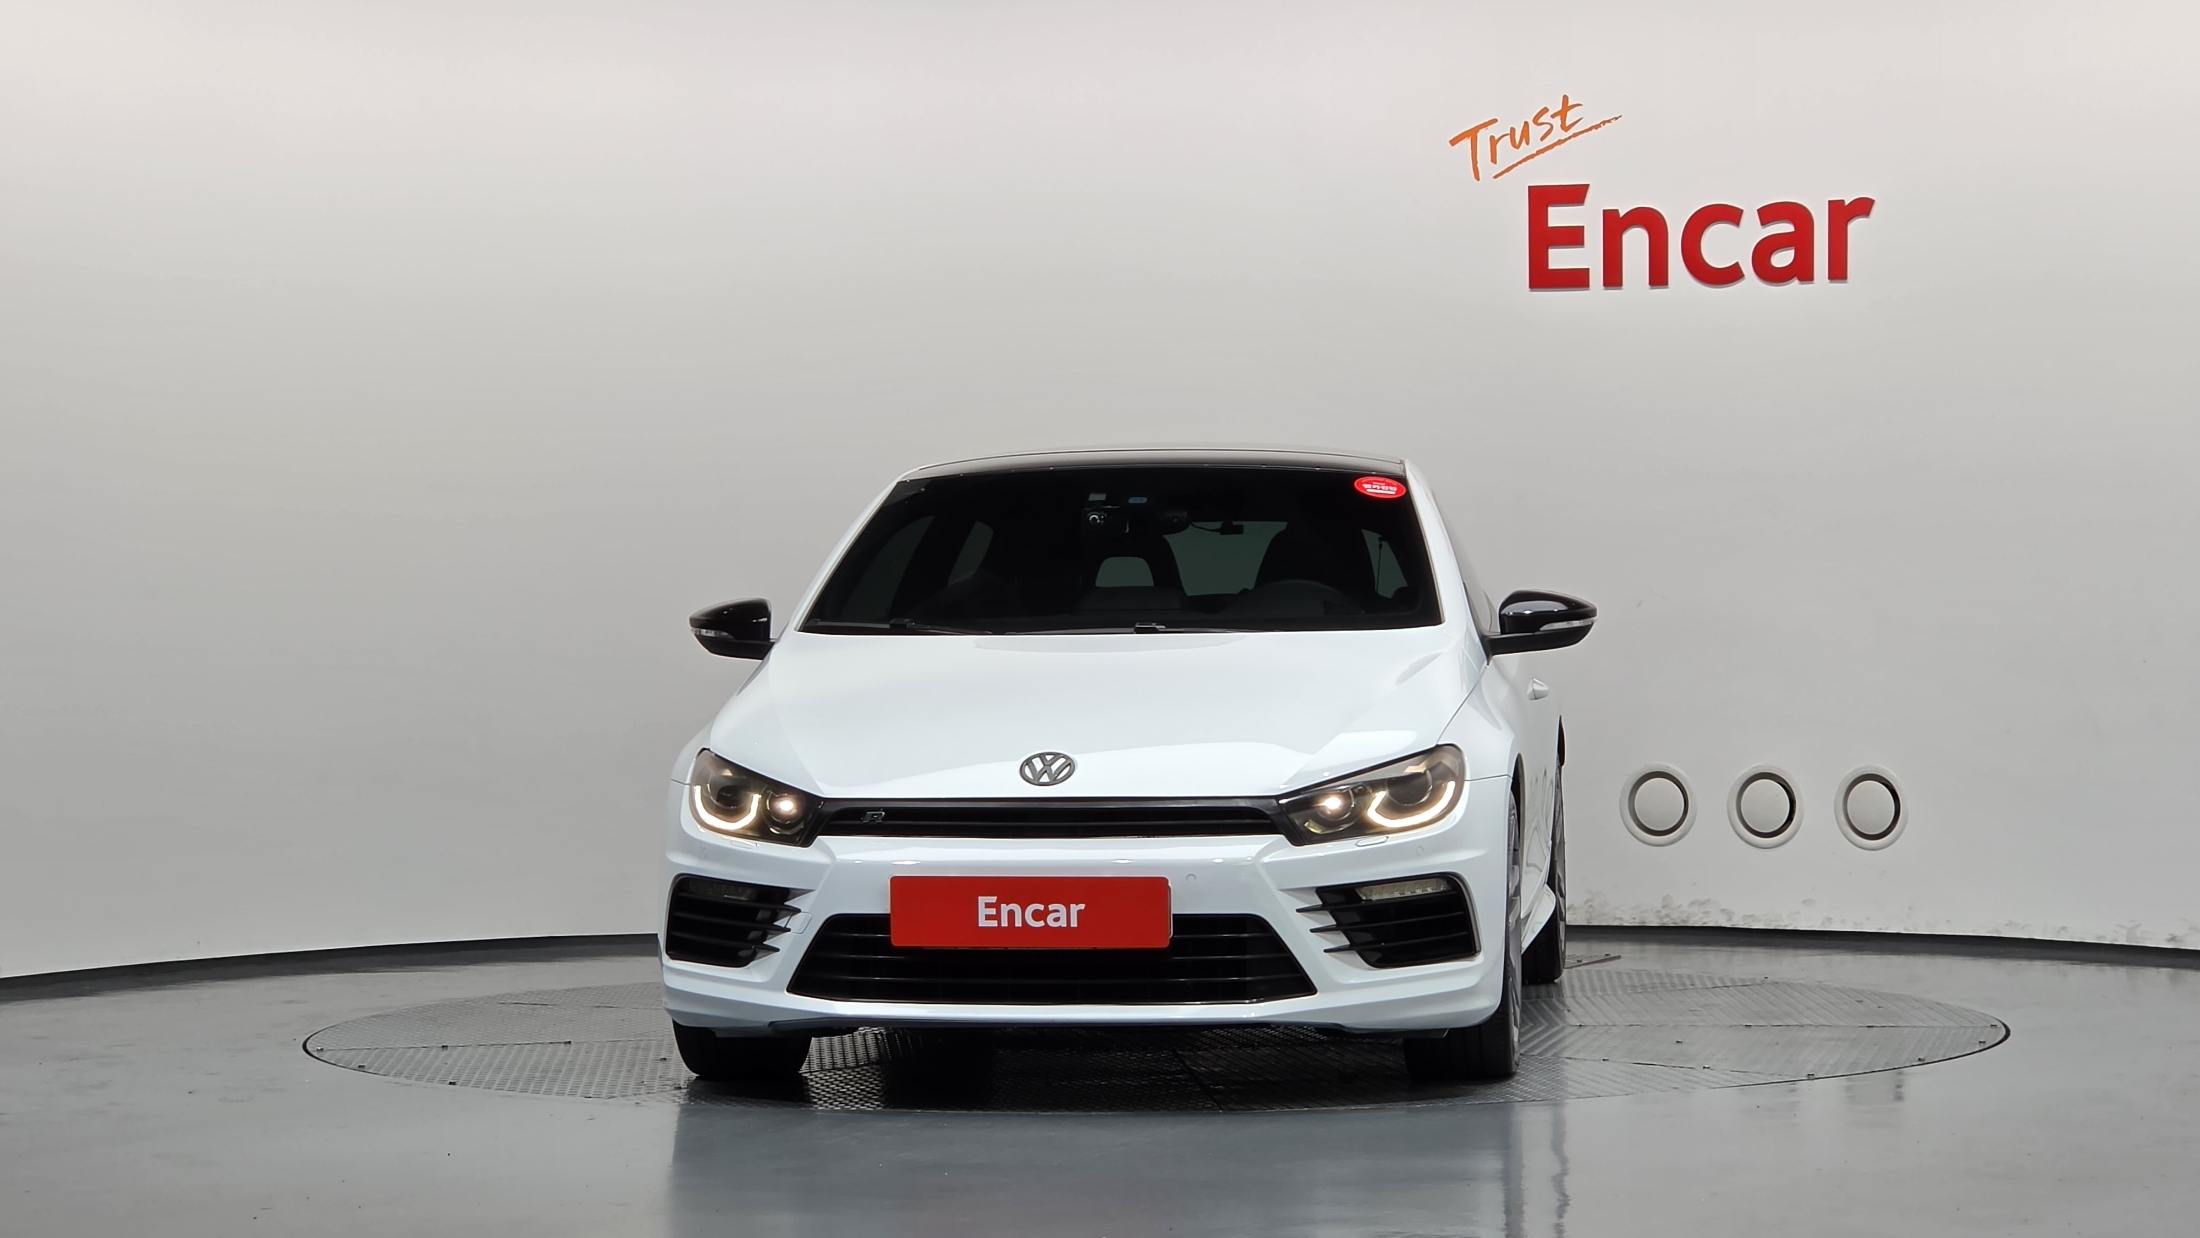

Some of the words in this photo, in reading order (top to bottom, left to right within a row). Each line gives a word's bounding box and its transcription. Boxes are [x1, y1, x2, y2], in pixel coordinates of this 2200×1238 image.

[1448, 94, 1584, 182] Trust
[1527, 183, 1876, 291] Encar
[861, 809, 886, 823] R
[977, 895, 1086, 928] Encar
